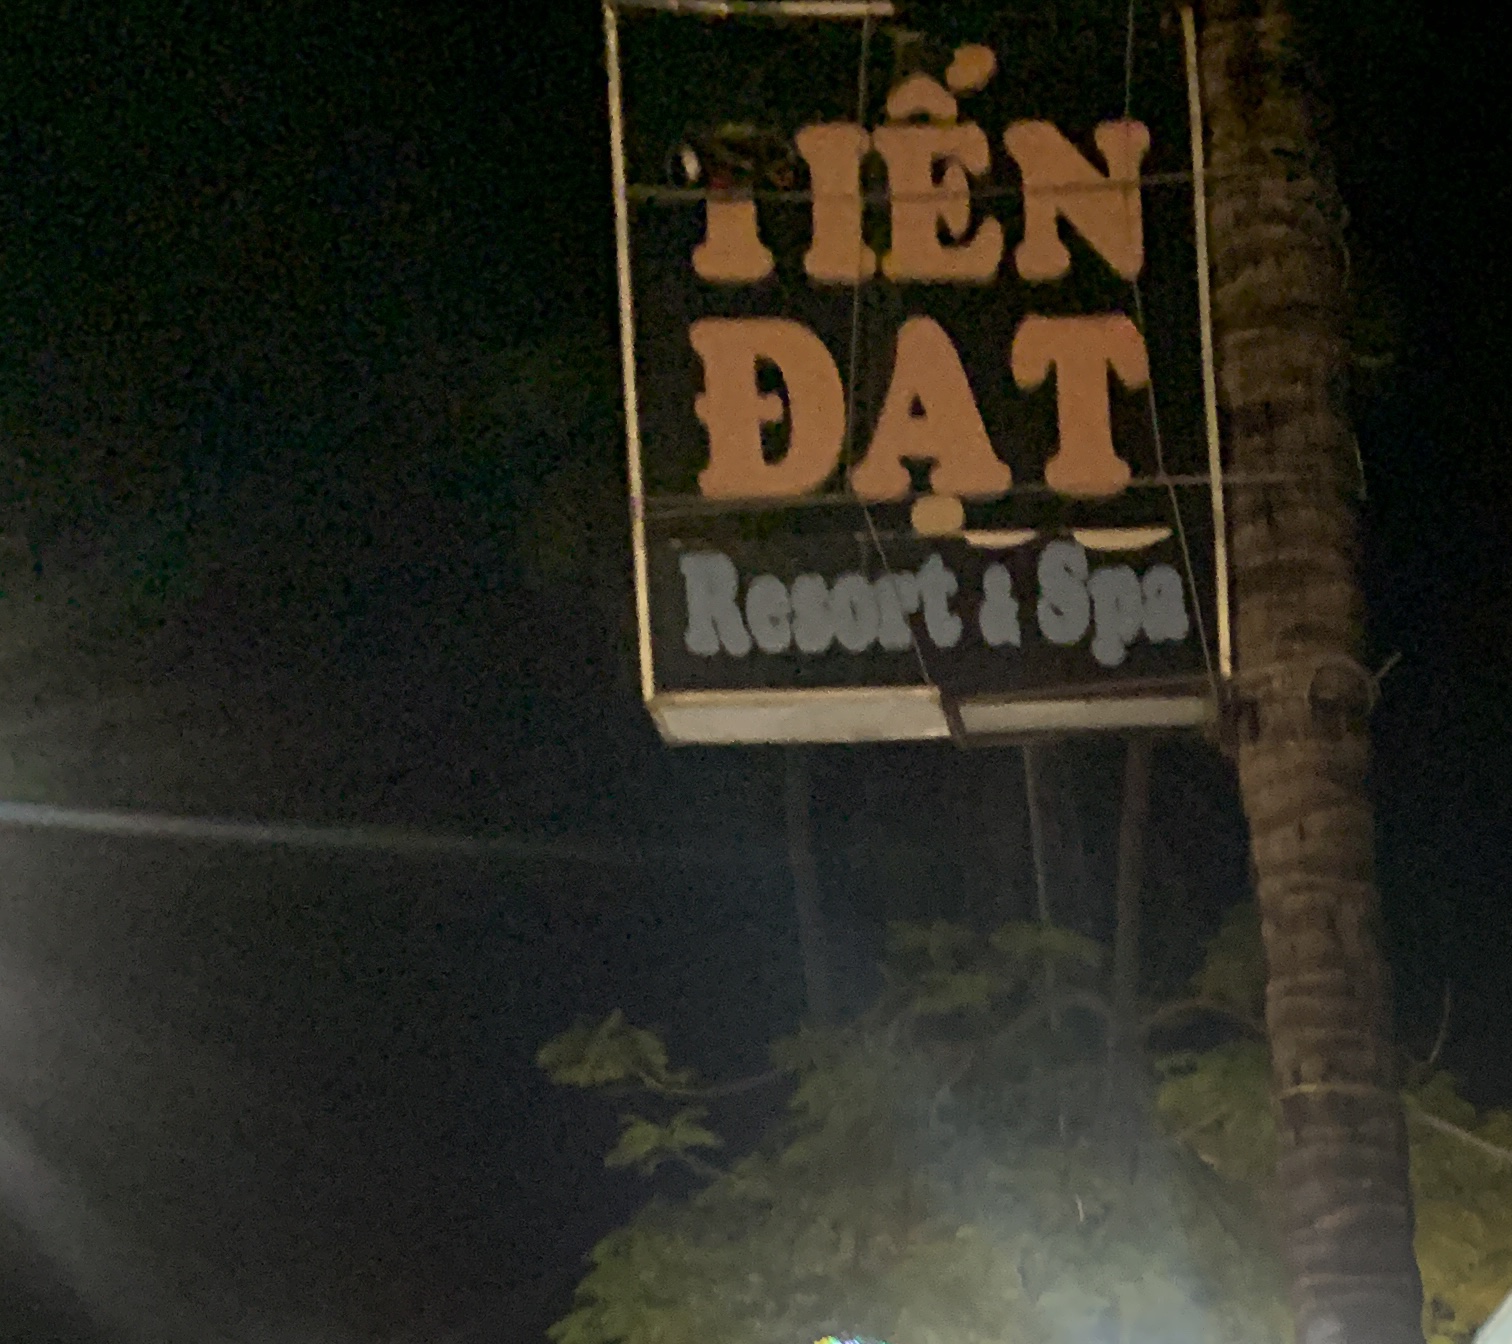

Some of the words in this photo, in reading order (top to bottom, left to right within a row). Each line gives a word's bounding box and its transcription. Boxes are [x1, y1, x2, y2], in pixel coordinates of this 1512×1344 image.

[688, 313, 1152, 537] ĐẠT
[680, 552, 963, 656] Resort
[1036, 541, 1190, 667] Spa
